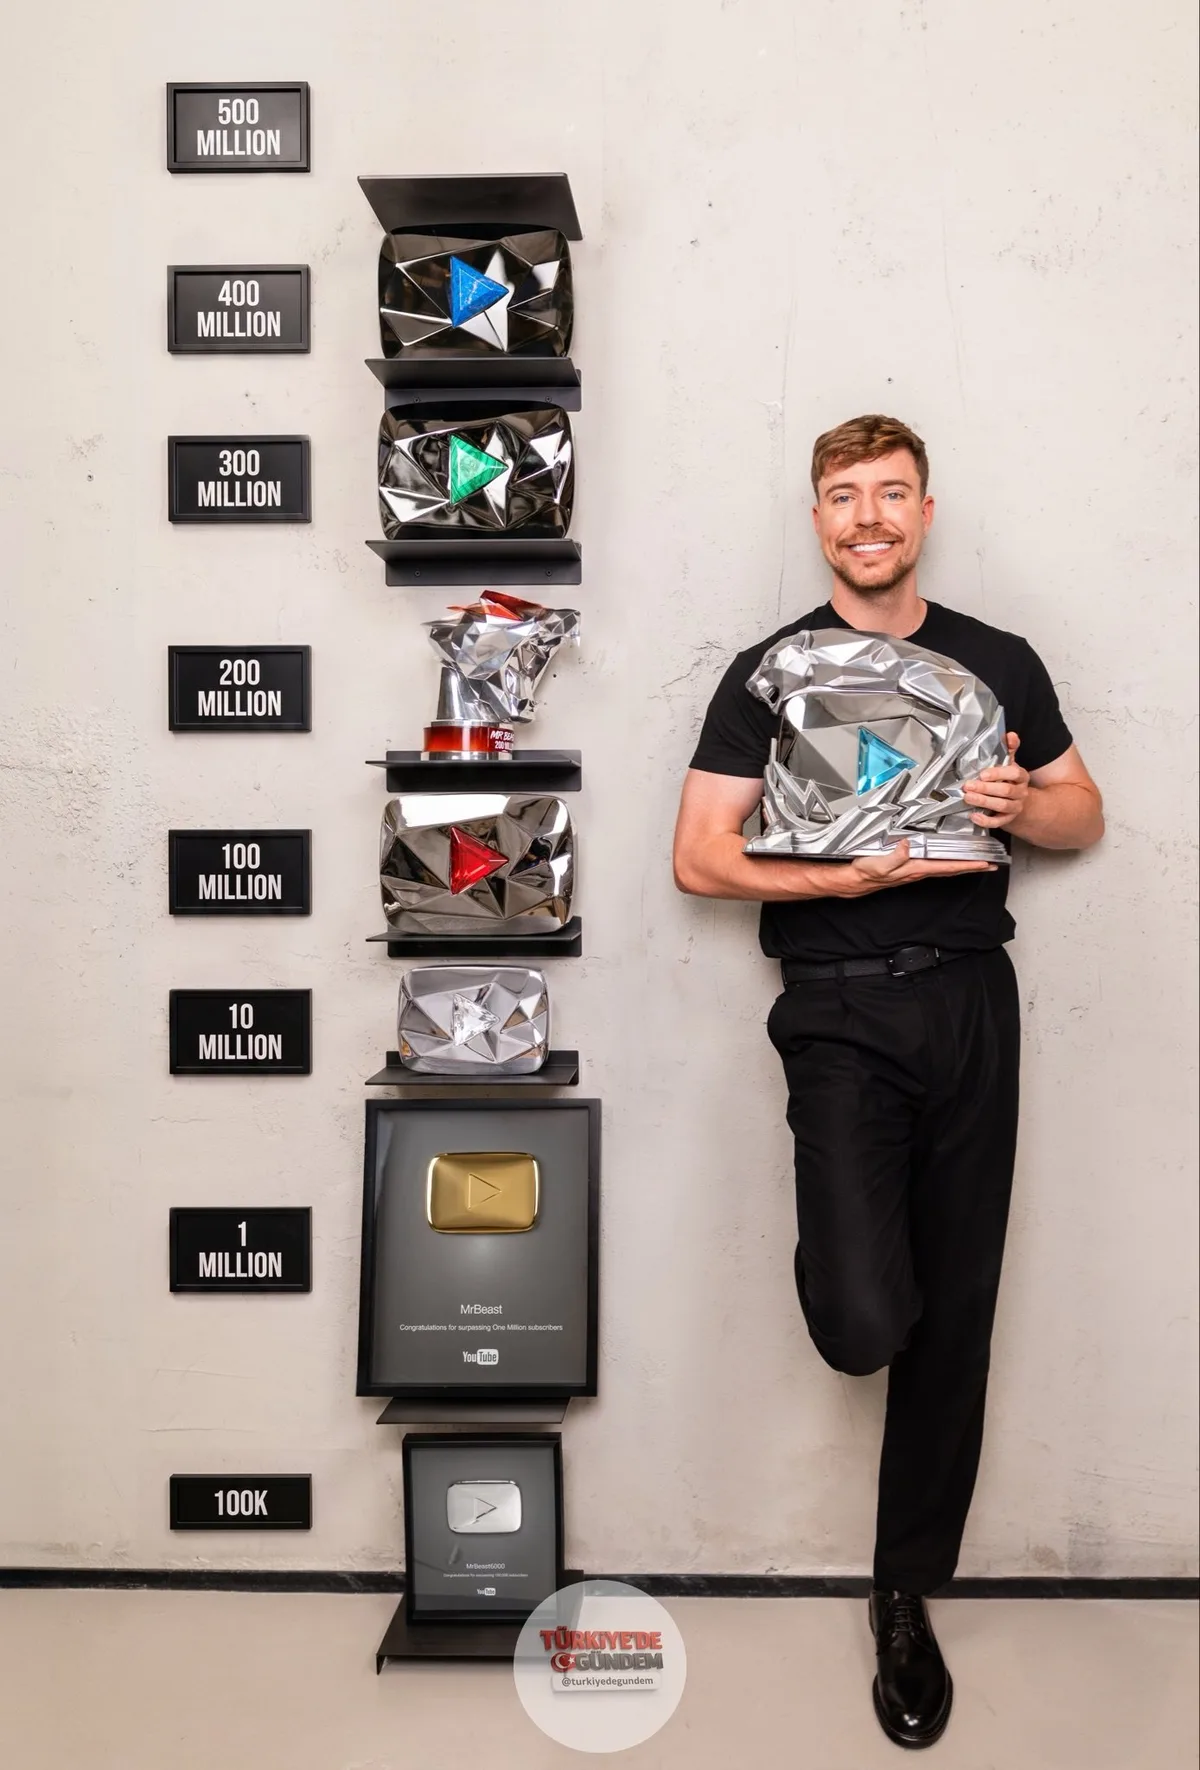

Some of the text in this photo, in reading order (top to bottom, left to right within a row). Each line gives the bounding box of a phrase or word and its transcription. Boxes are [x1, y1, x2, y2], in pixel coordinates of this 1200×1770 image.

[217, 98, 259, 125] 500
[196, 128, 281, 156] MILLION
[217, 279, 260, 307] 400
[196, 310, 281, 338] MILLION
[218, 449, 260, 477] 300
[197, 480, 282, 507] MILLION
[218, 659, 260, 686] 200
[197, 690, 282, 717] MILLION
[221, 843, 261, 870] 100
[198, 874, 282, 900] MILLION
[228, 1003, 254, 1029] 10
[198, 1033, 282, 1060] MILLION
[237, 1221, 247, 1247] 1
[198, 1251, 282, 1278] MILLION
[460, 1304, 503, 1315] MrBeast
[399, 1323, 447, 1332] Congratulations
[448, 1323, 457, 1331] for
[458, 1324, 491, 1332] surpassing
[462, 1349, 499, 1365] YouTube
[214, 1489, 268, 1516] 100K
